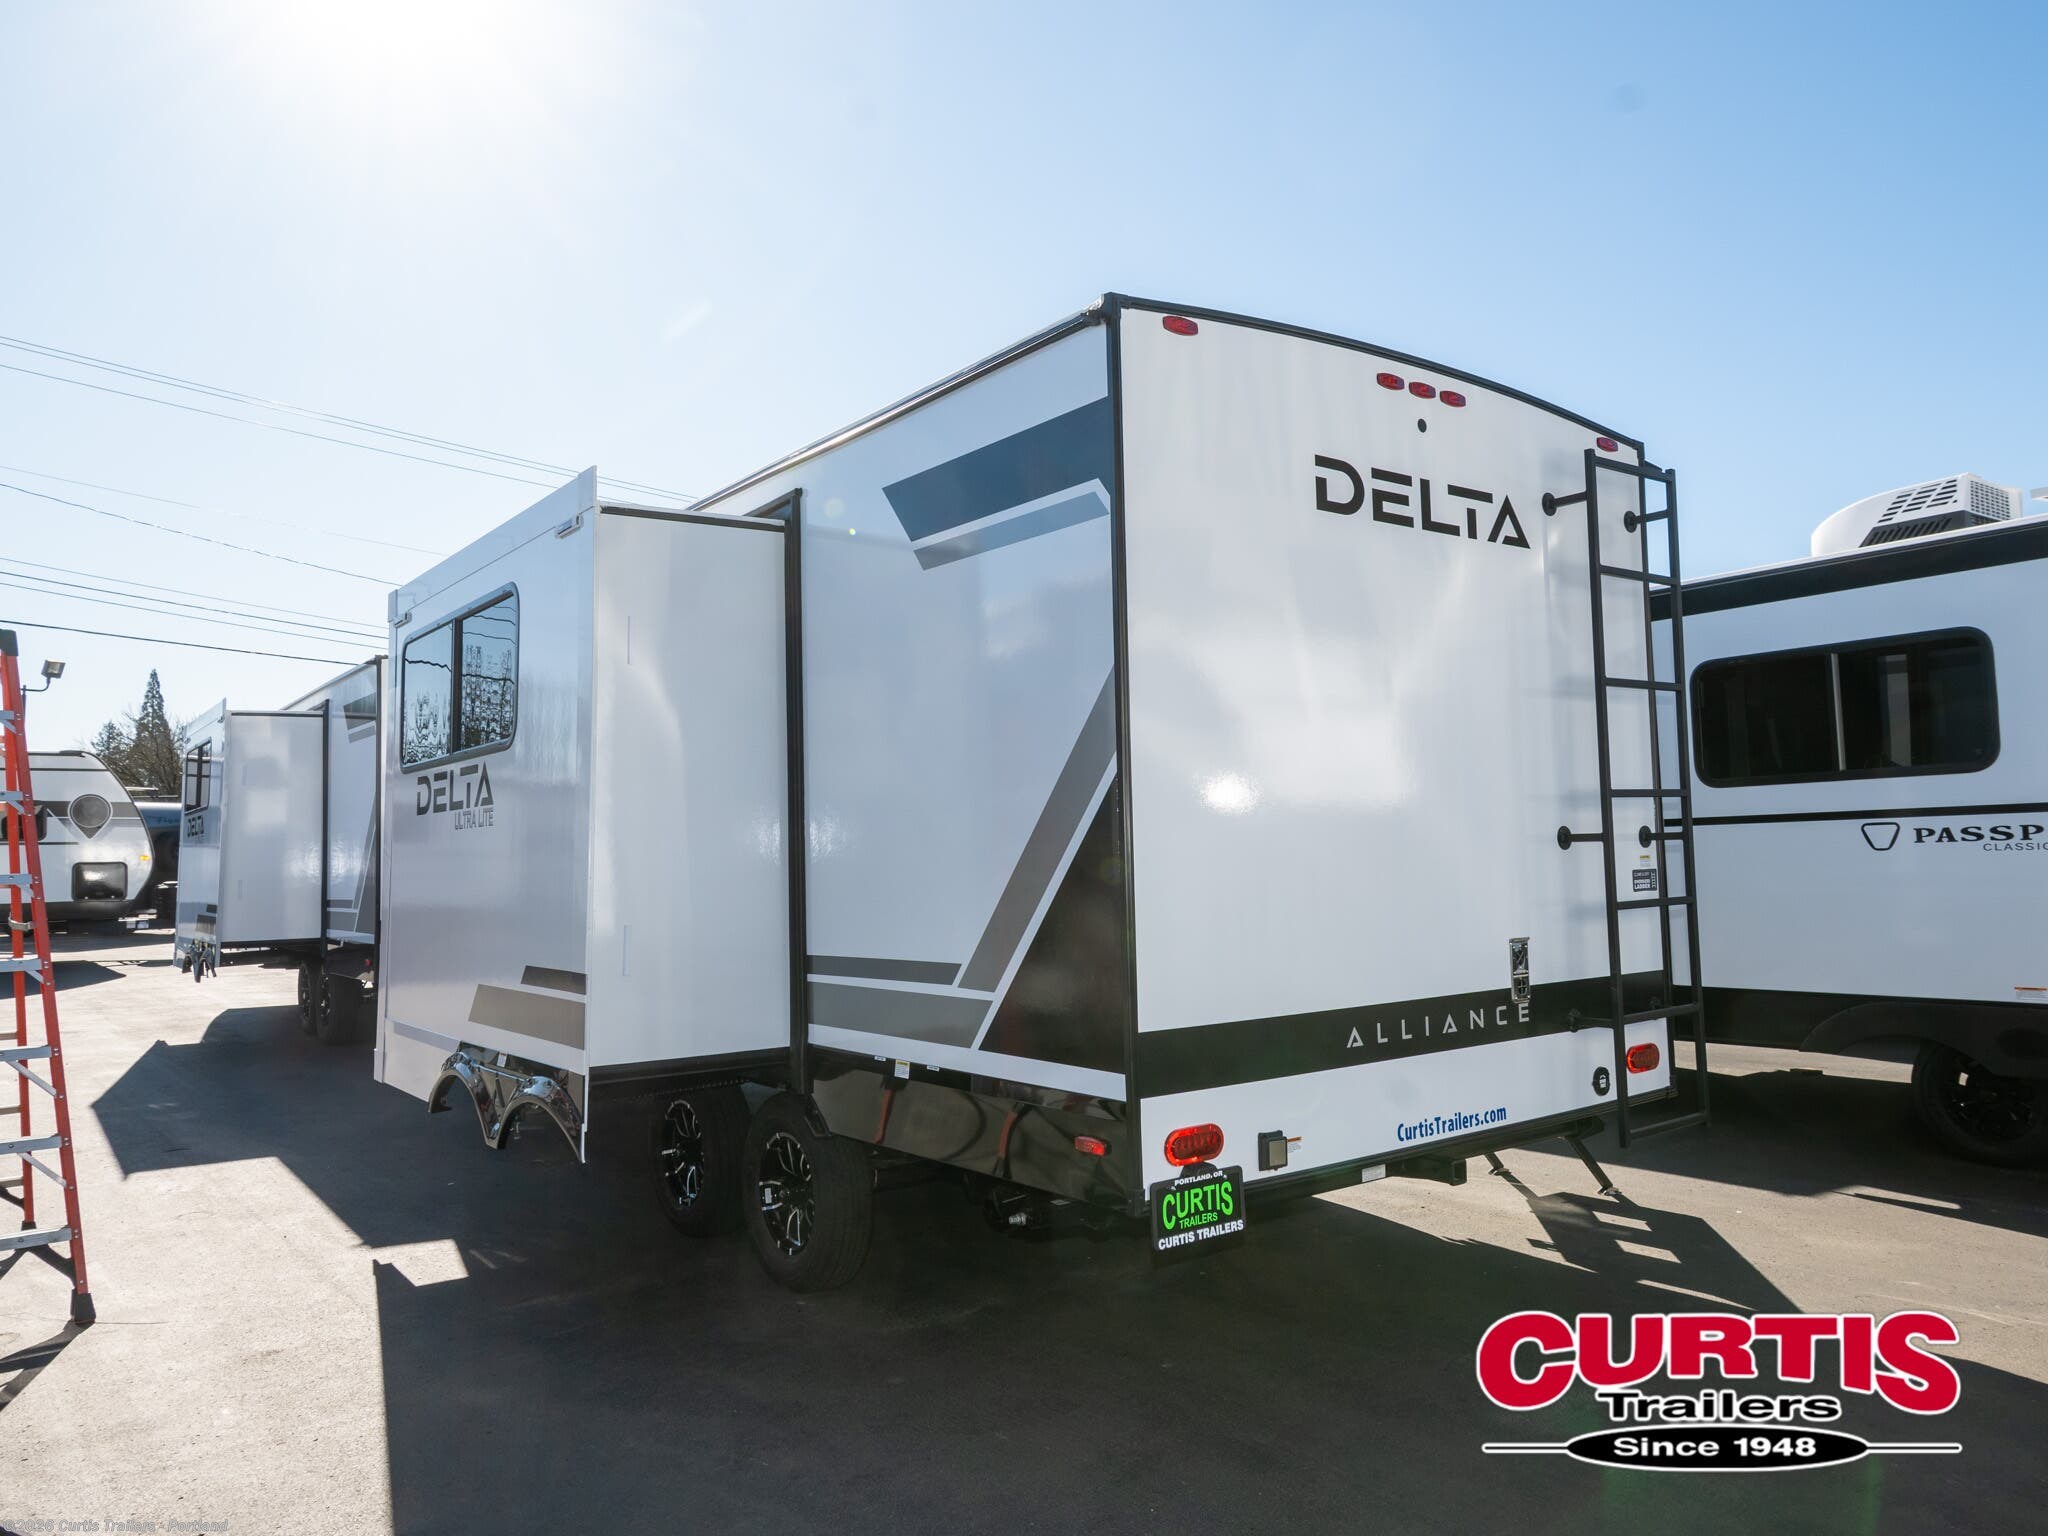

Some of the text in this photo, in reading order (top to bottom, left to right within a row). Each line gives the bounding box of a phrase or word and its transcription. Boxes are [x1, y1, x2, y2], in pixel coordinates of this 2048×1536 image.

[1315, 454, 1531, 549] DELTA
[417, 761, 494, 816] DELTA
[1912, 824, 2045, 844] PASSP
[1346, 1003, 1530, 1048] ALLIANCE
[1397, 1107, 1507, 1142] CurtisTrailers.com
[1162, 1181, 1234, 1230] CURTIS
[1179, 1212, 1218, 1230] TRAILERS
[1158, 1219, 1244, 1250] CURTIS TRAILERS
